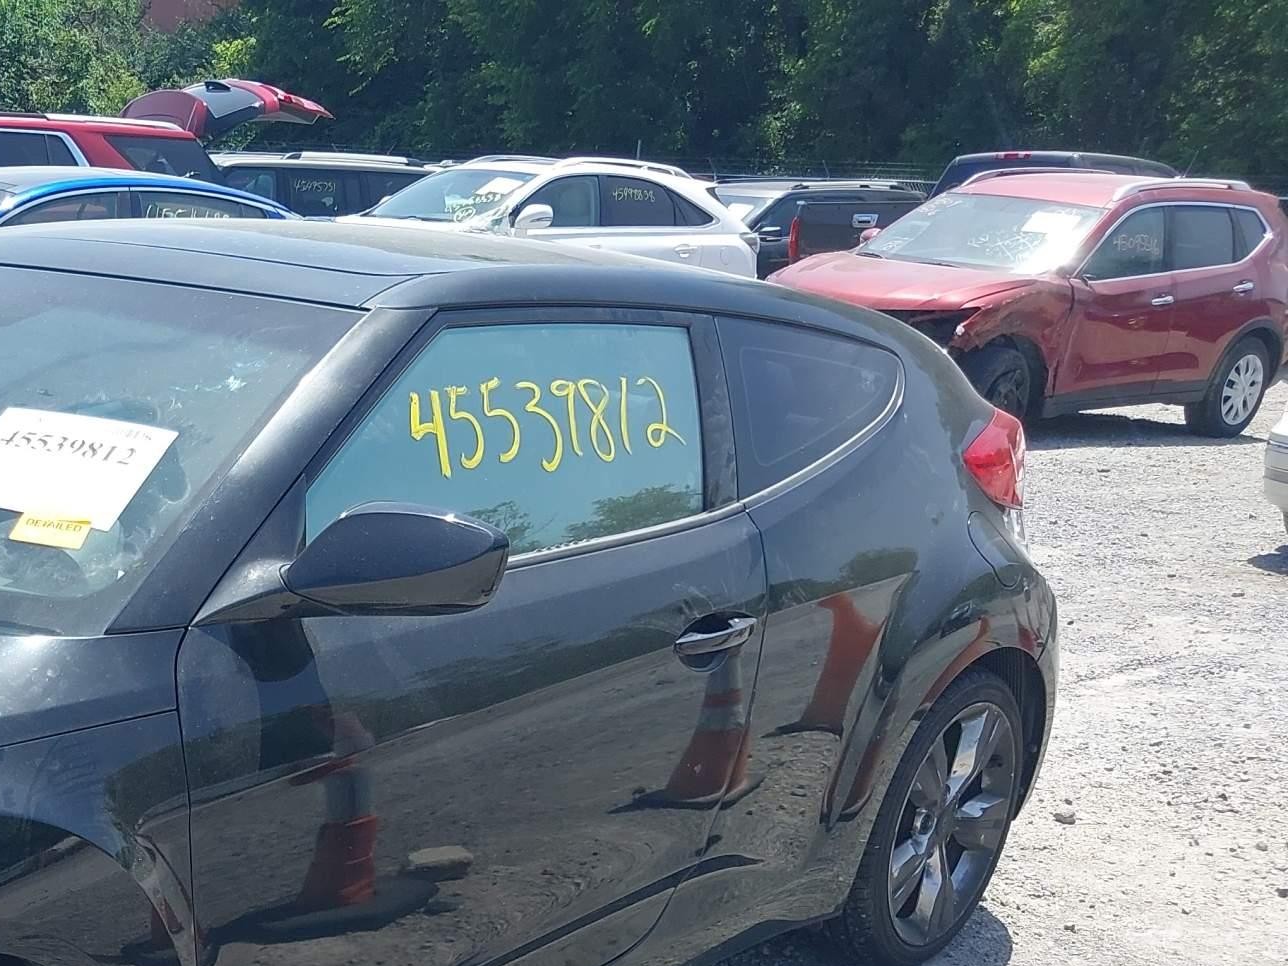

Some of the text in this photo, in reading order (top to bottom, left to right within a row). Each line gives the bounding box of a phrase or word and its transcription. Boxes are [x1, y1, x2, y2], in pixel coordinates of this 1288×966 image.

[410, 376, 687, 479] 45539812
[0, 430, 137, 465] 45539812
[25, 517, 84, 533] DETAILED
